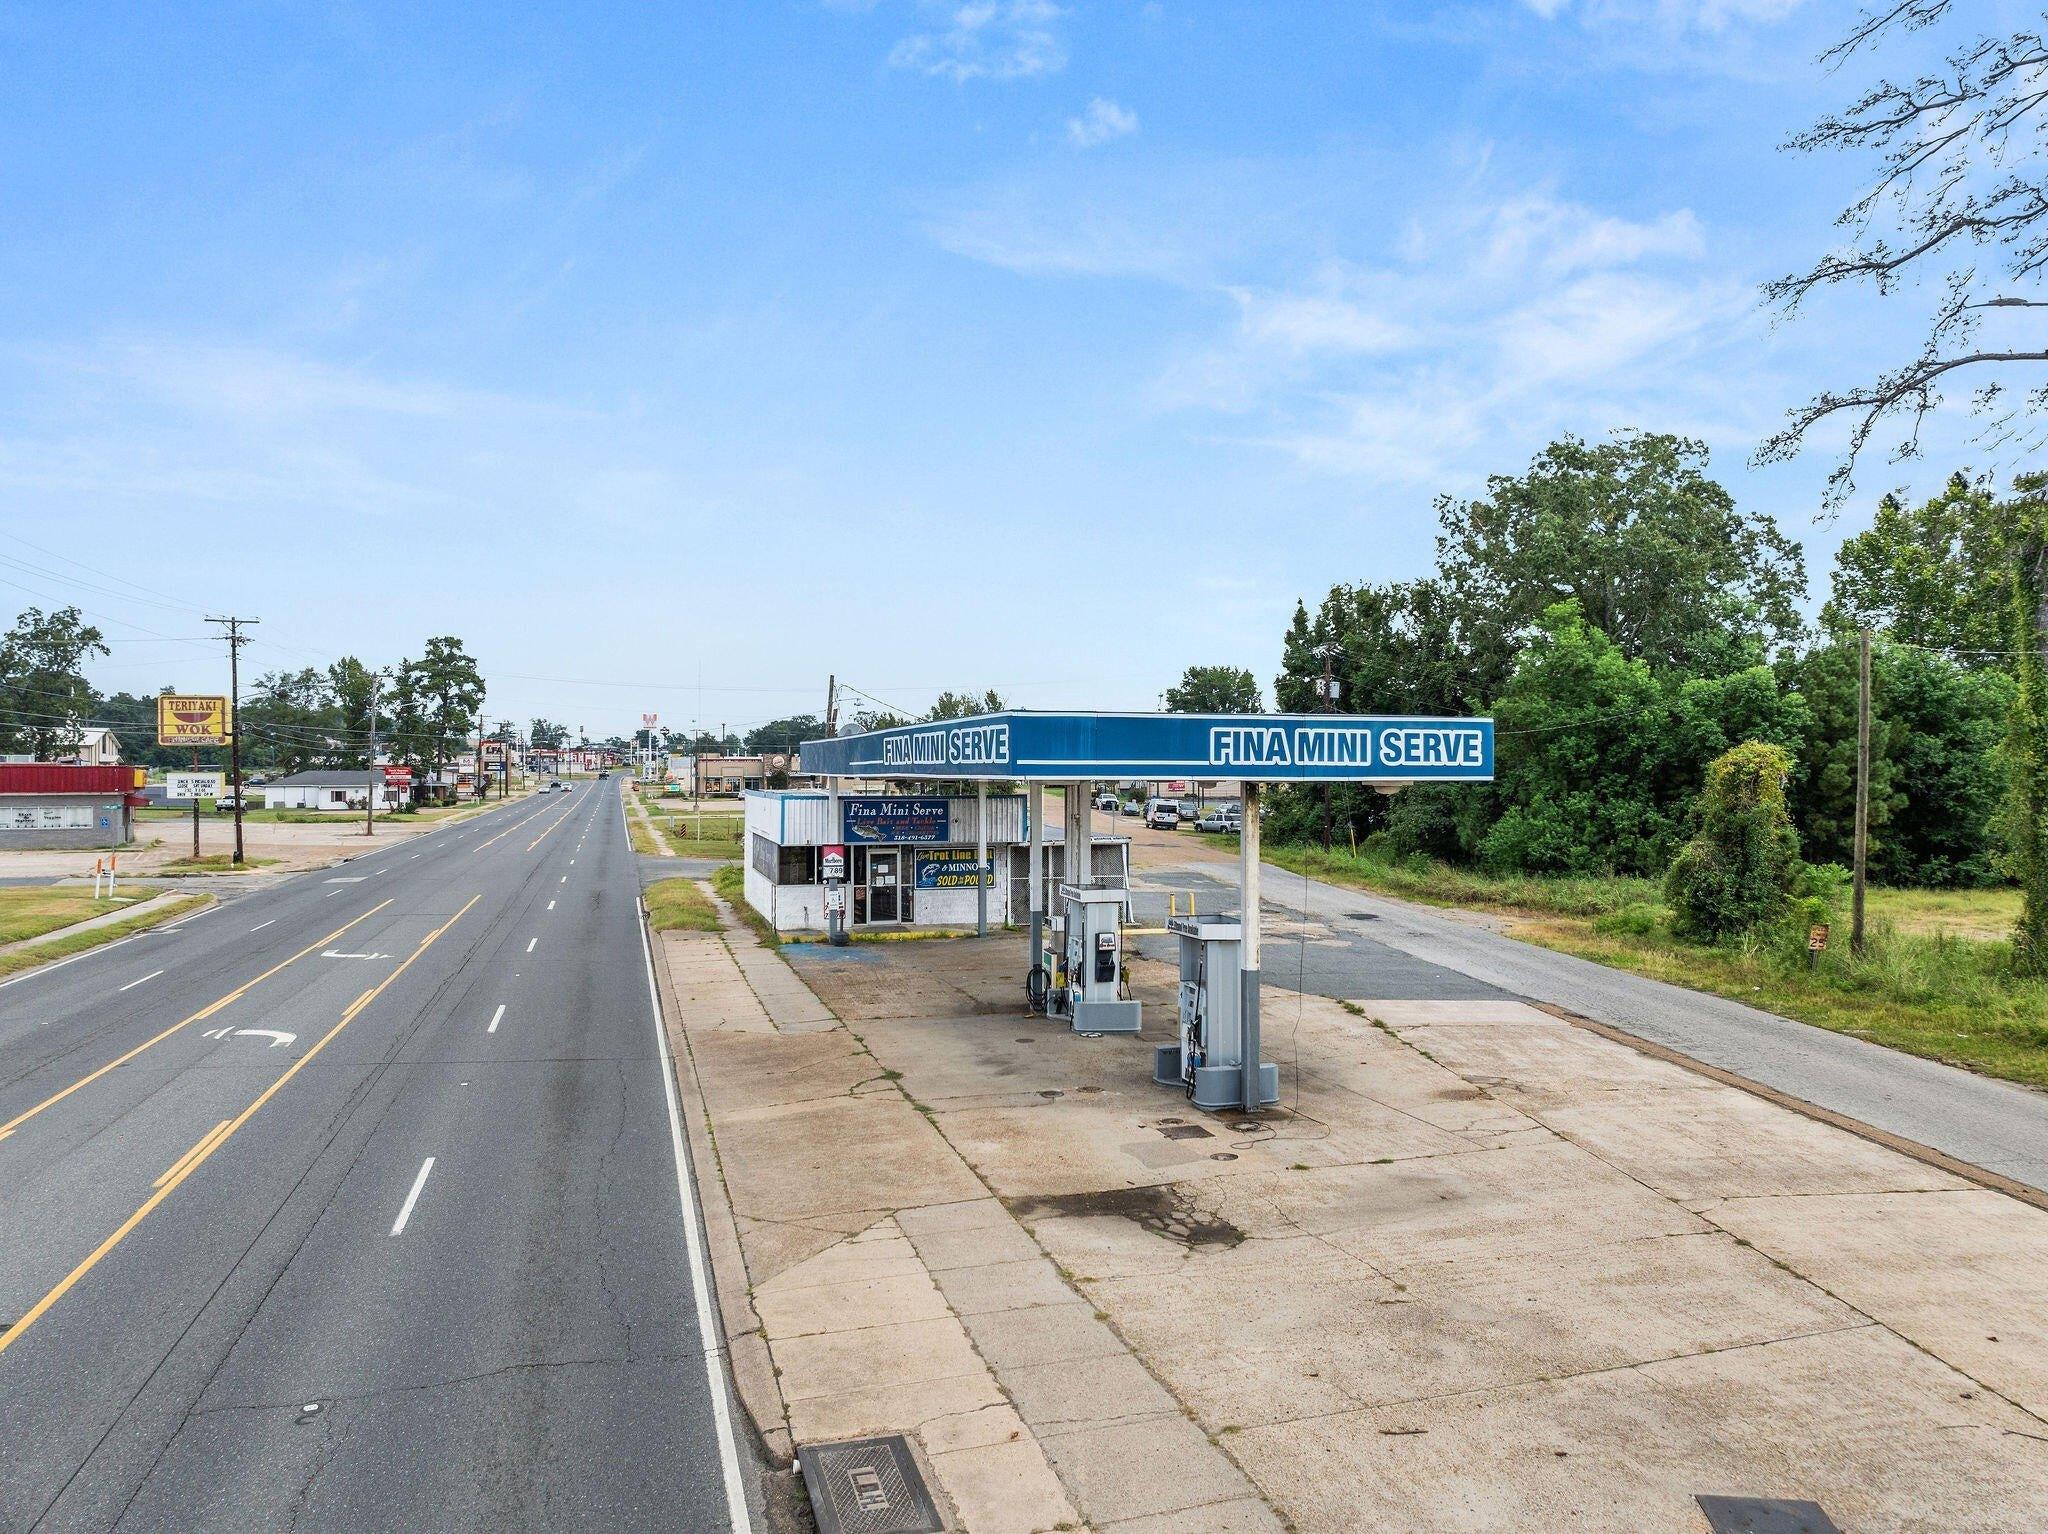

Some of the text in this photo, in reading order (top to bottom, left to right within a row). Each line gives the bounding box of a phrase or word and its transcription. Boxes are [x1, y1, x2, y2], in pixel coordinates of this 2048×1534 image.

[169, 701, 217, 711] TERIYAKI
[175, 725, 211, 734] WOK
[884, 724, 1009, 765] FINA MINI SERVE
[1210, 728, 1482, 766] FINA MINI SERVE
[850, 803, 944, 816] Fina Mini Serve
[929, 850, 949, 860] Trot
[952, 850, 971, 860] Line
[949, 863, 990, 871] MINNOS
[937, 875, 957, 886] SOLD
[1810, 937, 1825, 947] 25
